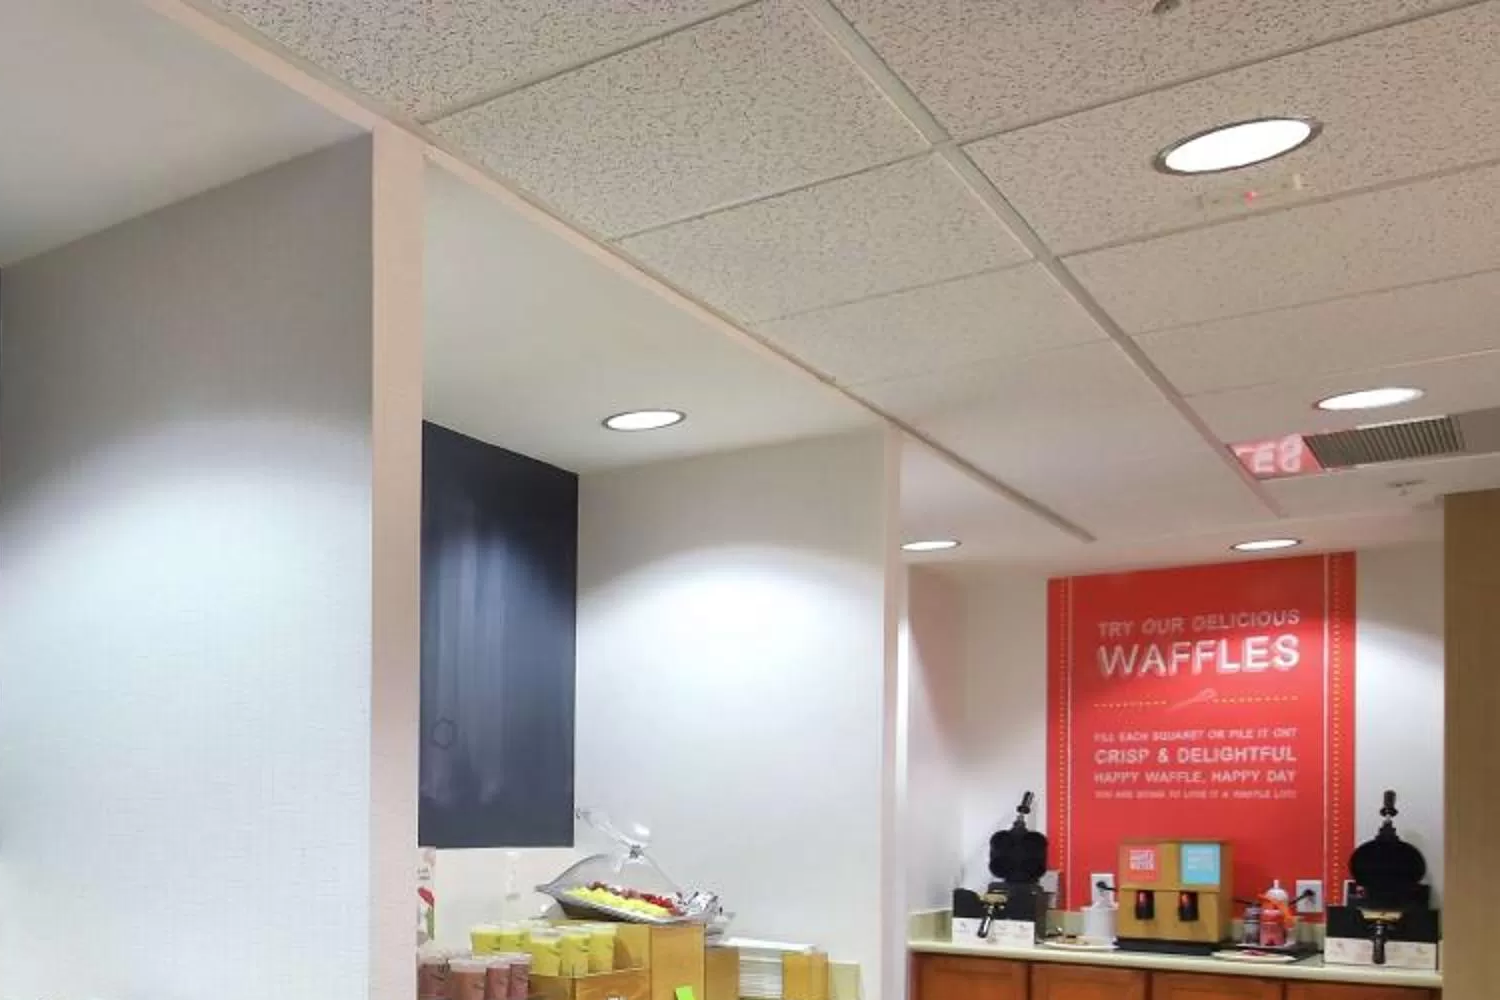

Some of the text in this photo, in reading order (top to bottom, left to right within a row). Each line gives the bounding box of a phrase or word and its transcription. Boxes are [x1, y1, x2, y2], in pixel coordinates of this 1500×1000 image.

[1098, 608, 1300, 638] TRY OUR DELICIOUS
[1096, 633, 1300, 678] WAFFLES
[1094, 745, 1297, 765] CRISP & DELIGHTFUL
[1094, 771, 1140, 785] HAPPY
[1211, 769, 1261, 783] HAPPY
[1266, 769, 1297, 783] DAY
